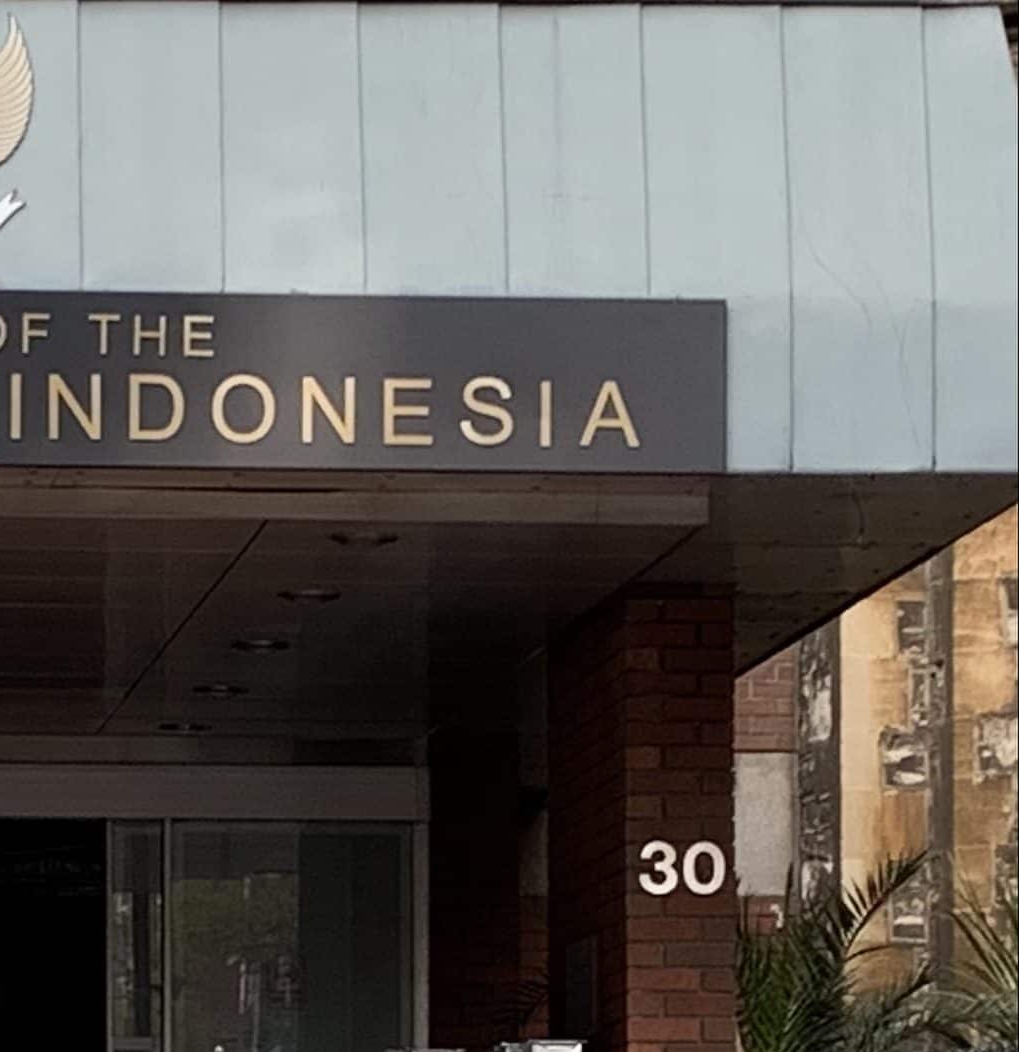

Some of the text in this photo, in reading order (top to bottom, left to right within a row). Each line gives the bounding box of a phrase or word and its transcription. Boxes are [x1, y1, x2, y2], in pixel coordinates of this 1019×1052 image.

[88, 313, 215, 358] THE
[10, 373, 641, 449] INDONESIA
[639, 841, 725, 895] 30
